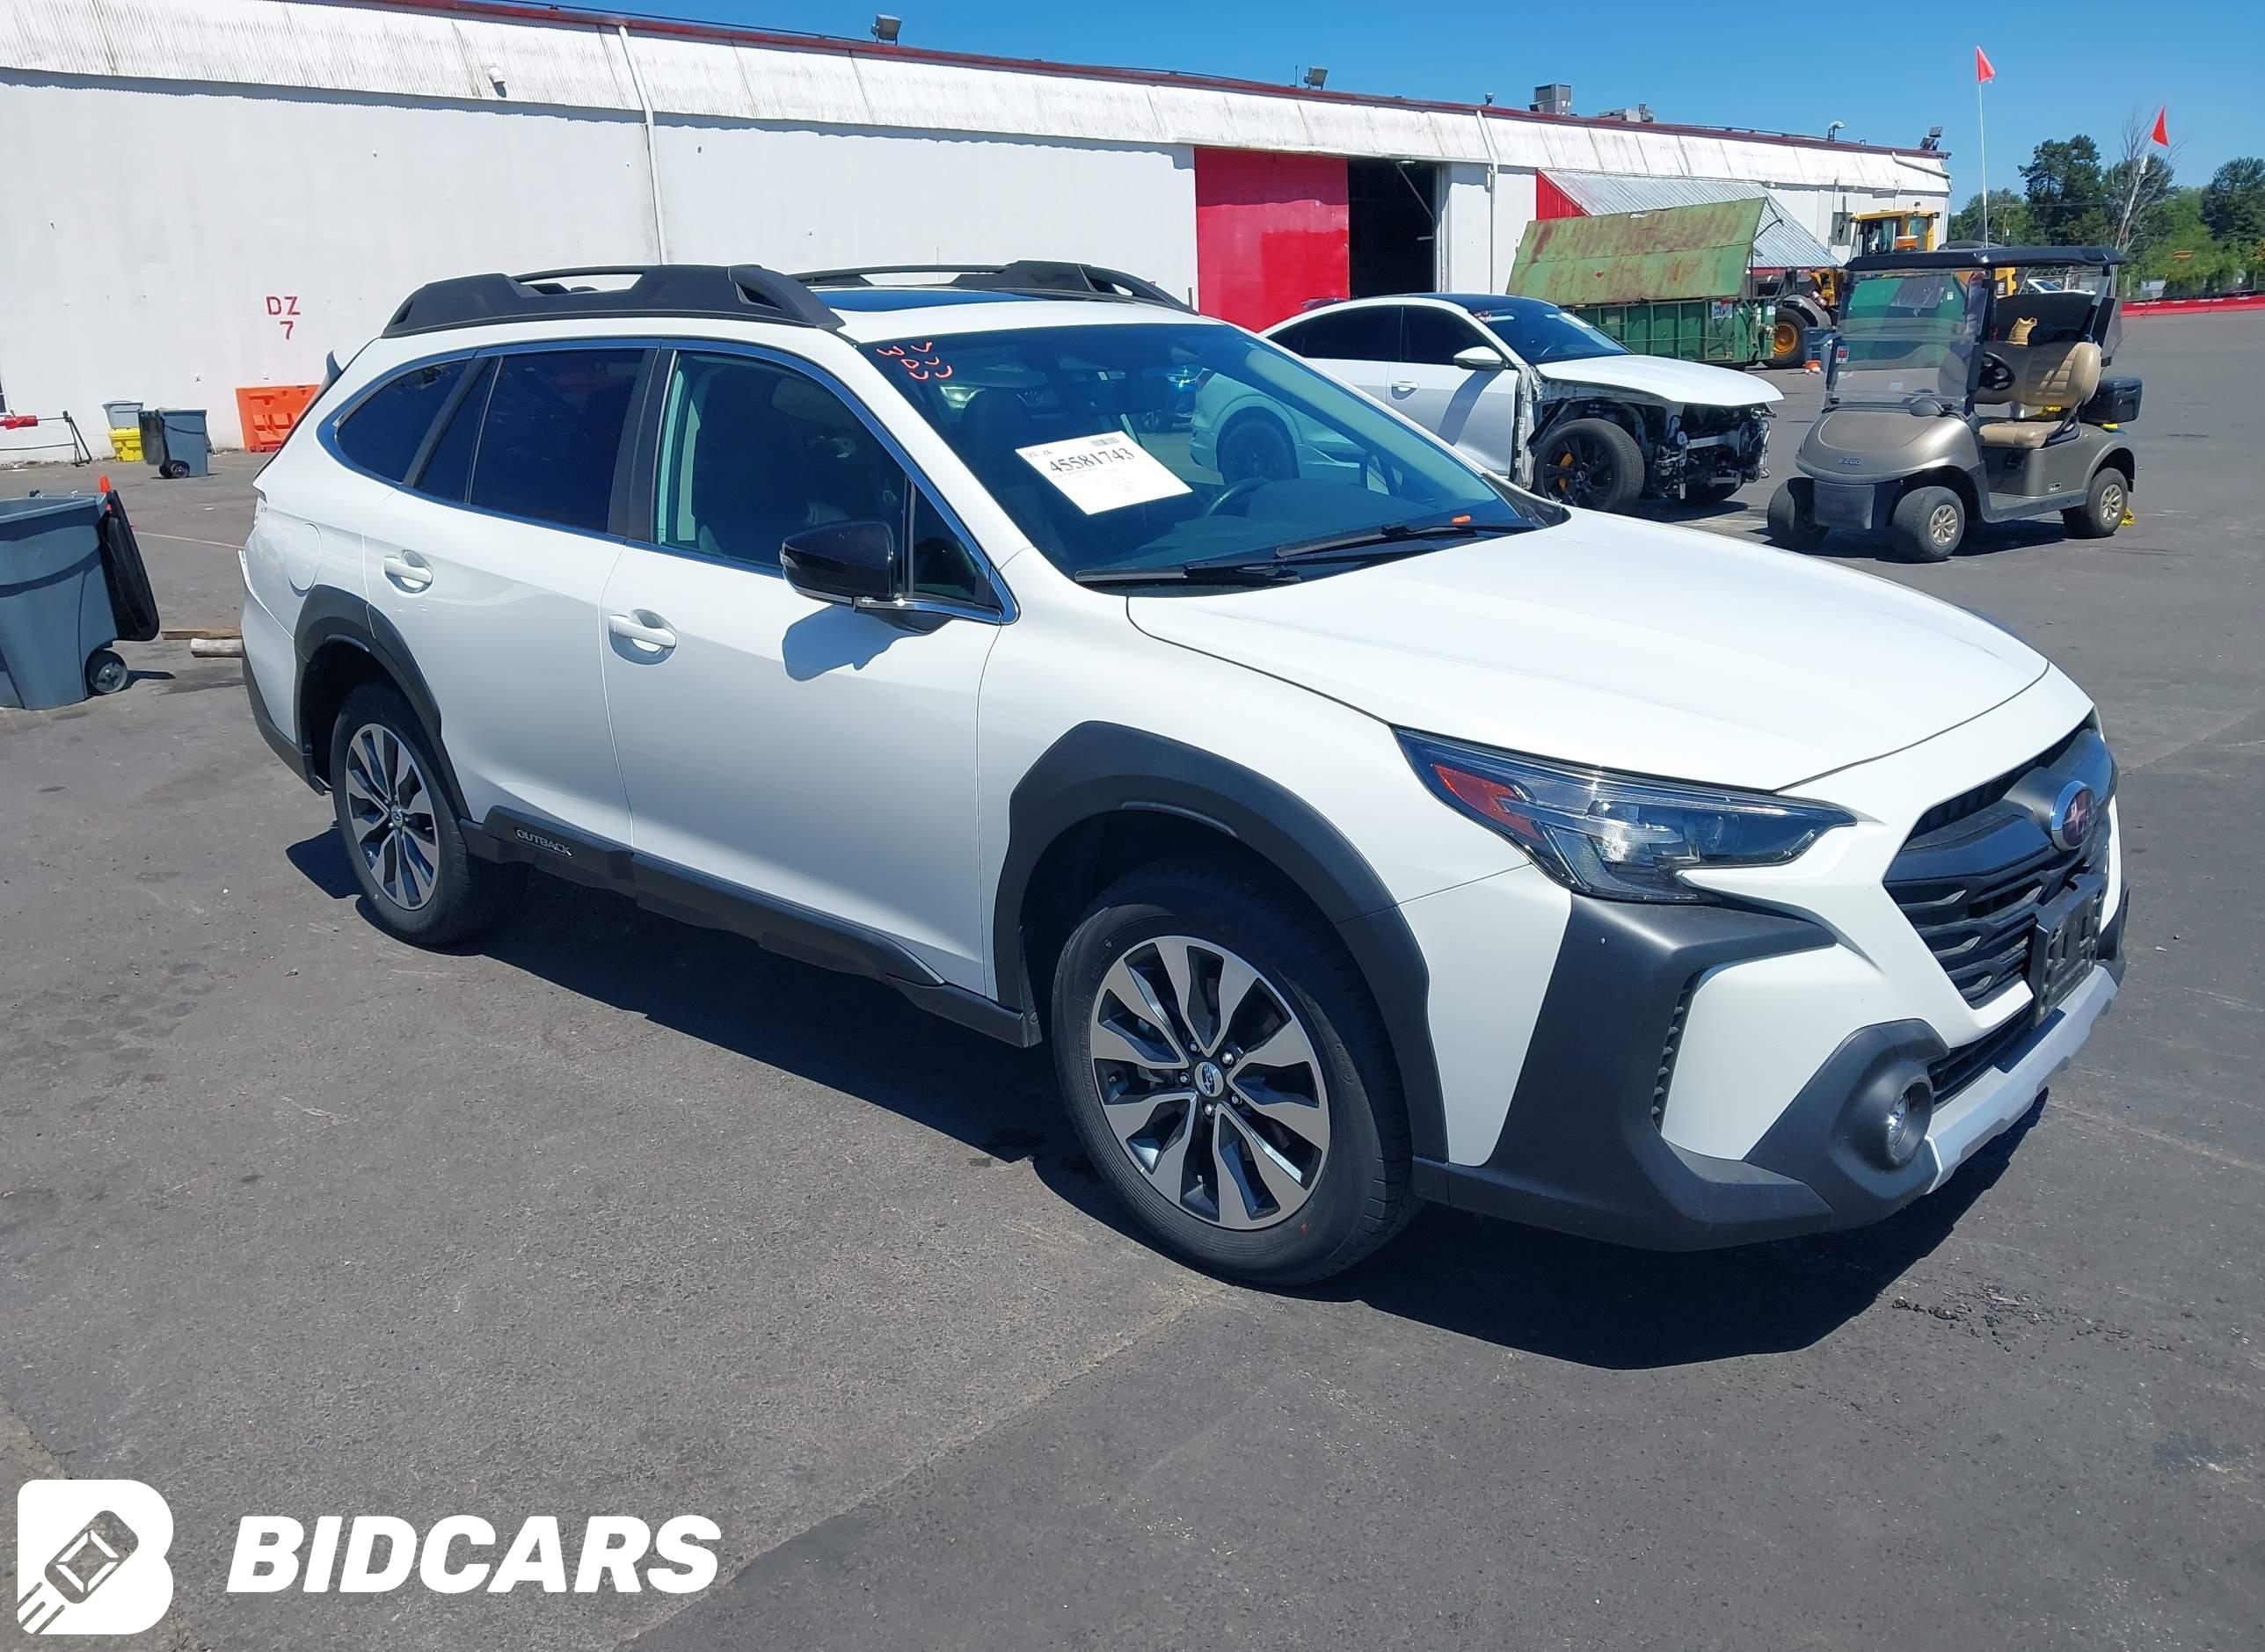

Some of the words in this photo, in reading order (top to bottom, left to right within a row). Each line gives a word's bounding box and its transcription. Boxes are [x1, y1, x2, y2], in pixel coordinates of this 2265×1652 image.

[266, 296, 301, 316] DZ
[280, 321, 294, 340] 7
[1050, 448, 1134, 472] 45581743
[516, 829, 572, 856] OUTBACK
